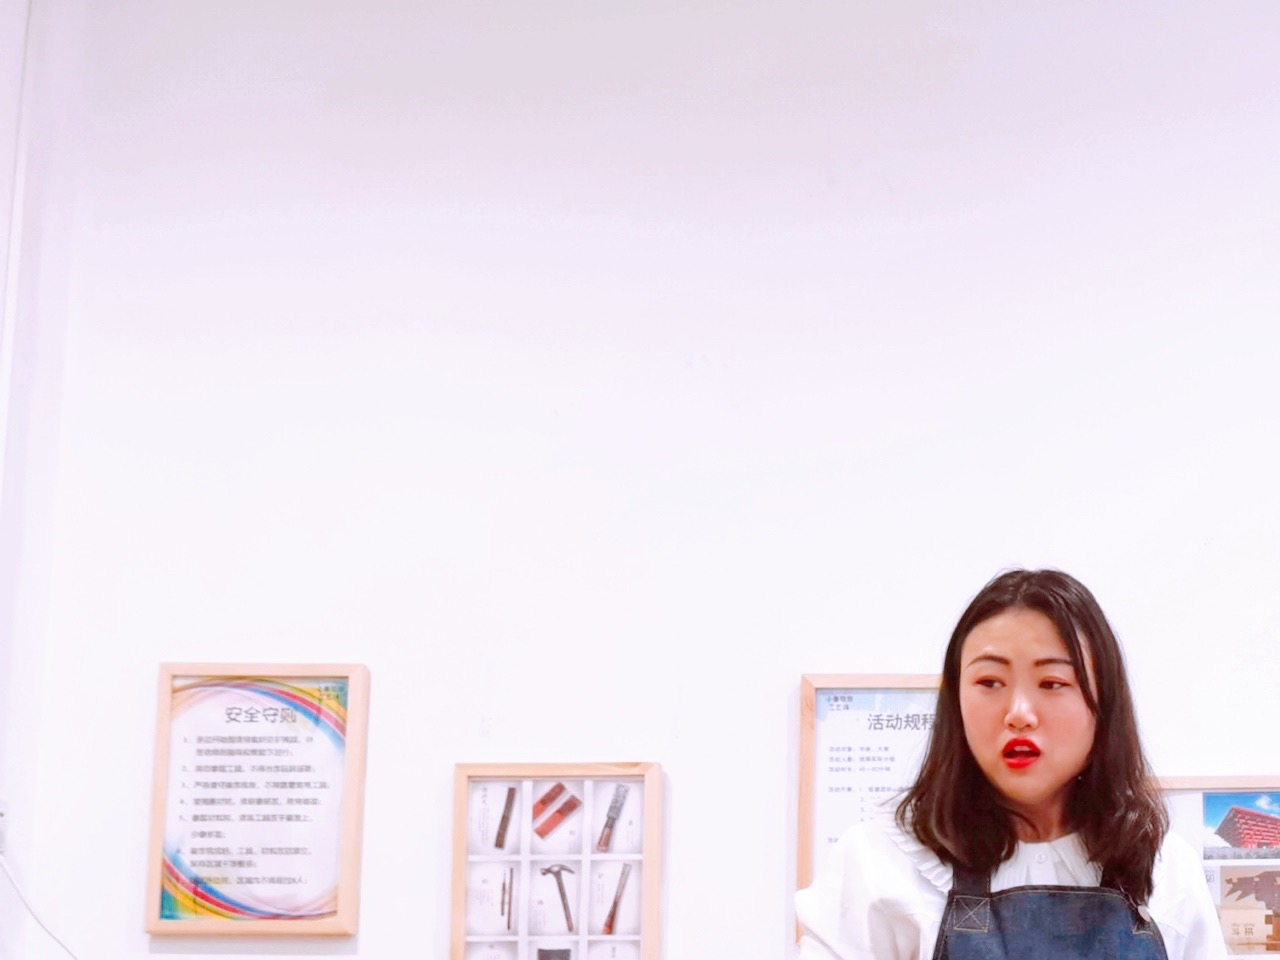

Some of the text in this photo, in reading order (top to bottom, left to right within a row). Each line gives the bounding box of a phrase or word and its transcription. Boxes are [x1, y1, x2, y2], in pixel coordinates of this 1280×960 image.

[225, 706, 297, 723] 安全守则
[867, 713, 938, 730] 活动规程
